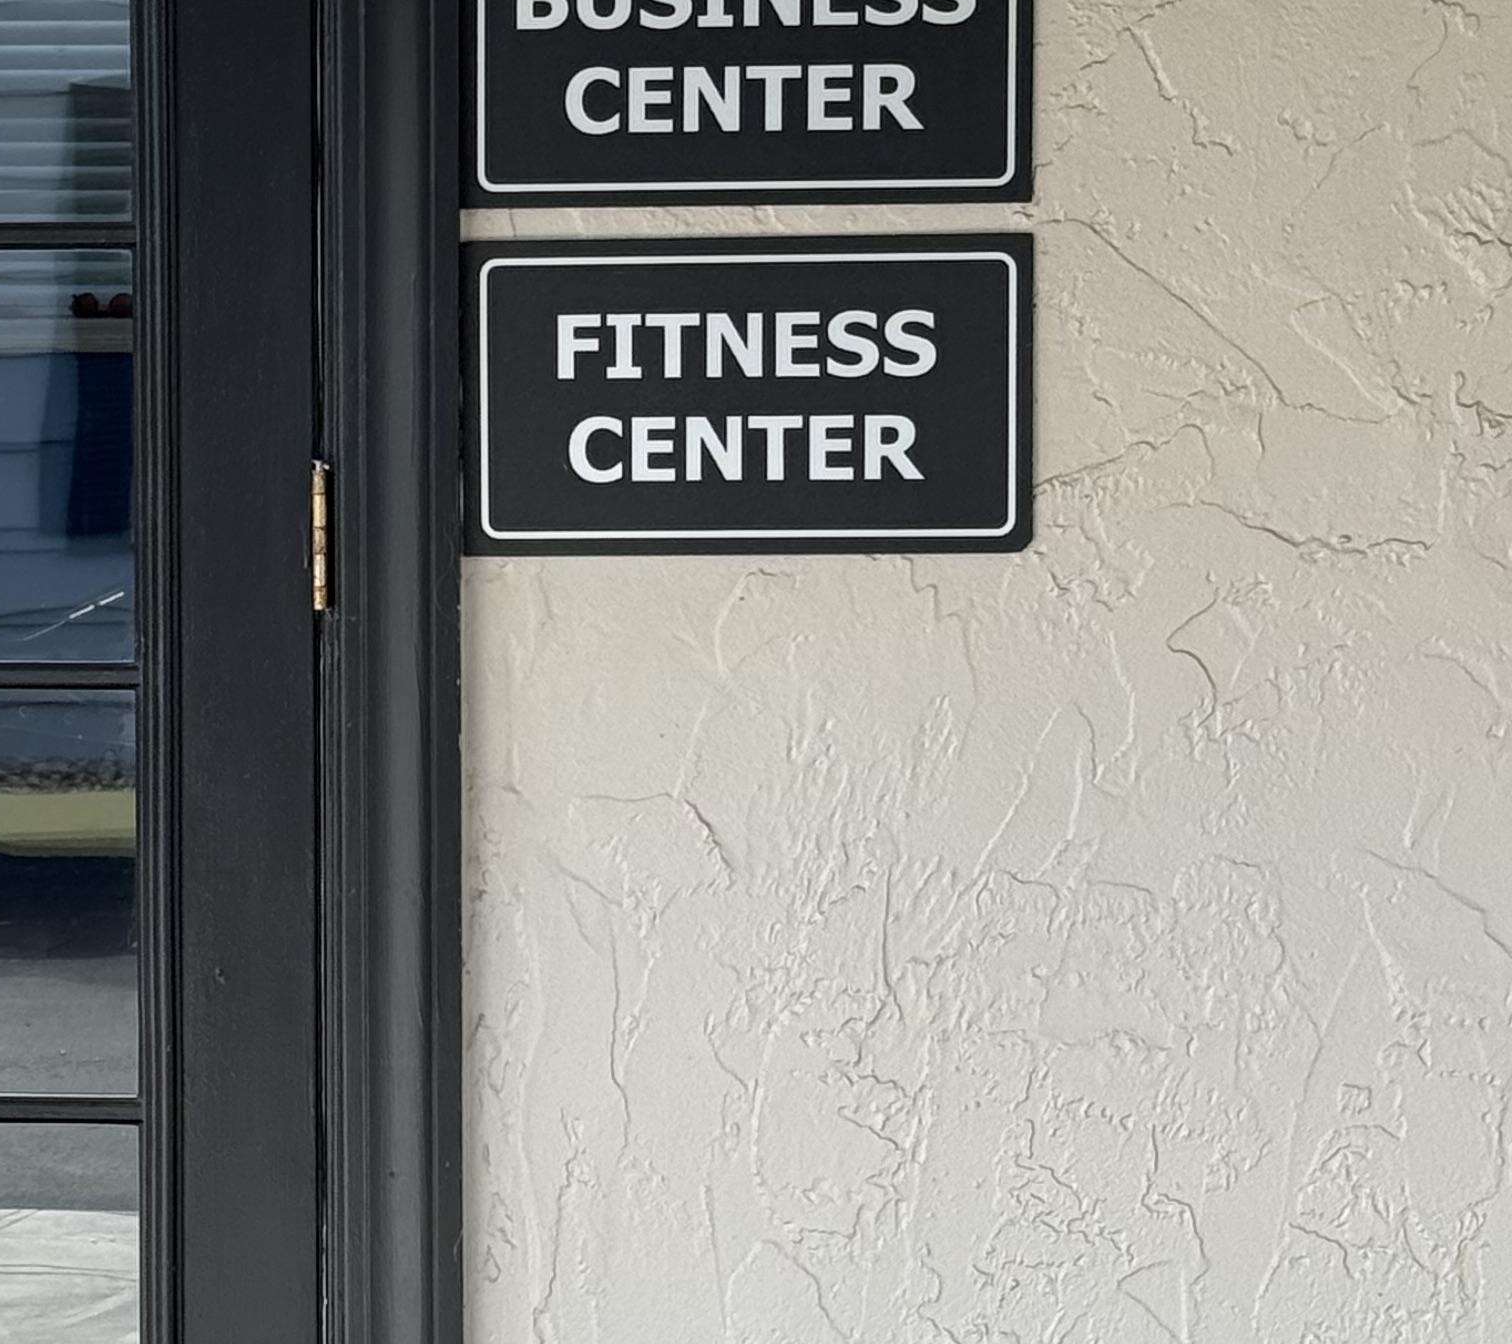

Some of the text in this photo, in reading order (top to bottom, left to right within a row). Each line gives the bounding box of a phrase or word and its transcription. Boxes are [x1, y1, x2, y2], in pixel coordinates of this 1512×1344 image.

[563, 63, 926, 135] CENTER
[556, 310, 938, 380] FITNESS
[568, 414, 926, 483] CENTER
